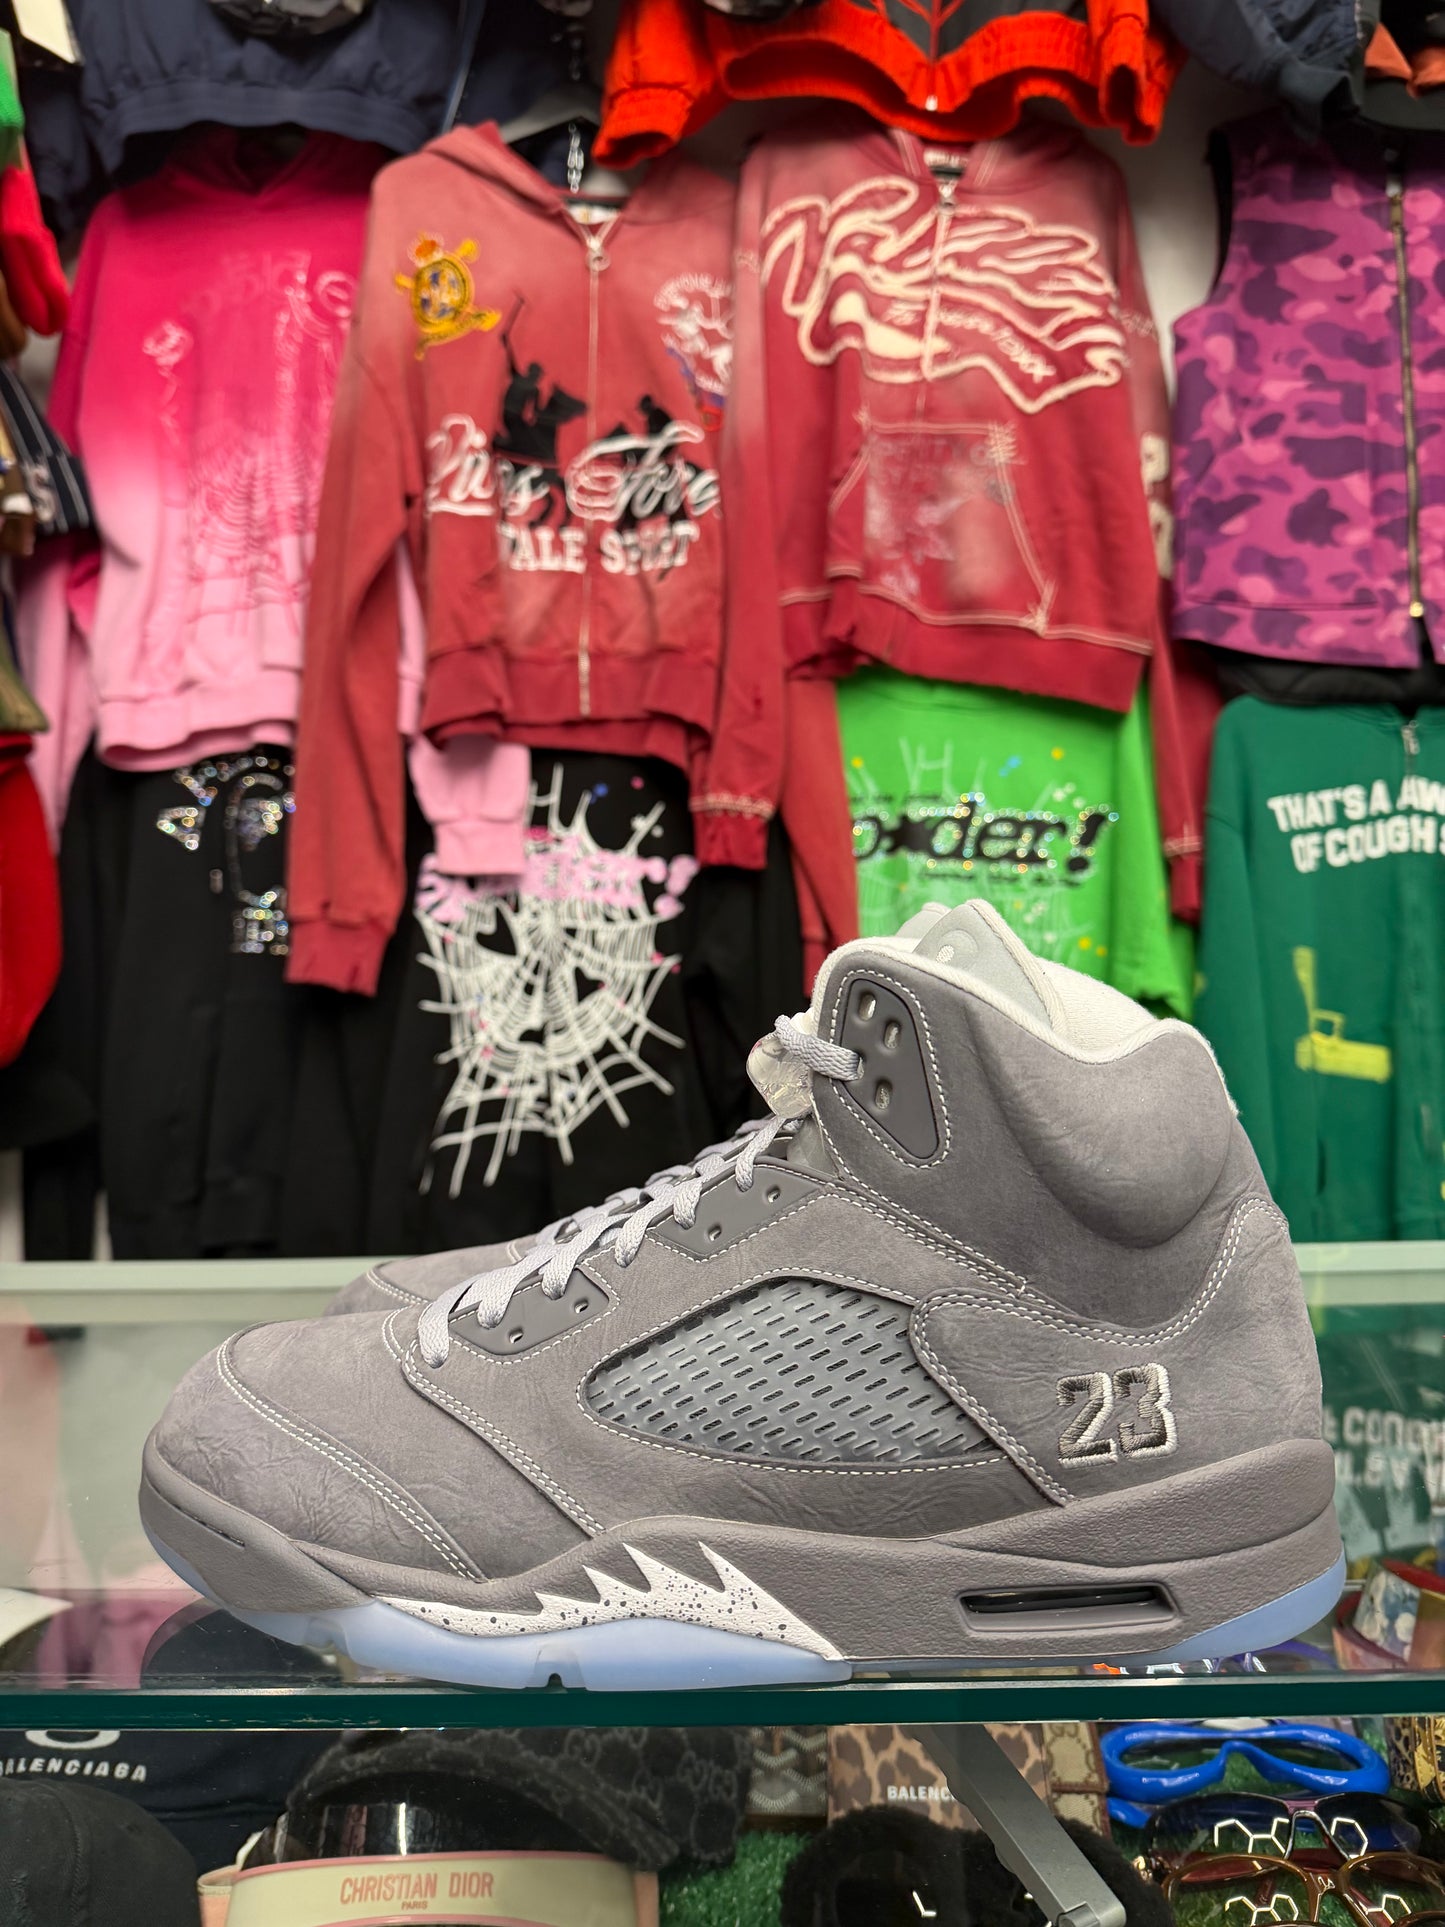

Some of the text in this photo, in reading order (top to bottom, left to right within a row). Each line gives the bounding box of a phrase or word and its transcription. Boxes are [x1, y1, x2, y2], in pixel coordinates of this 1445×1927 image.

[1267, 784, 1367, 832] THAT'S
[1369, 779, 1392, 816] A
[1291, 832, 1322, 873] OF
[1324, 814, 1437, 868] COUGH
[1057, 1362, 1177, 1468] 23
[340, 1872, 494, 1905] CHRISTIAN DIOR
[401, 1901, 428, 1910] PARIS
